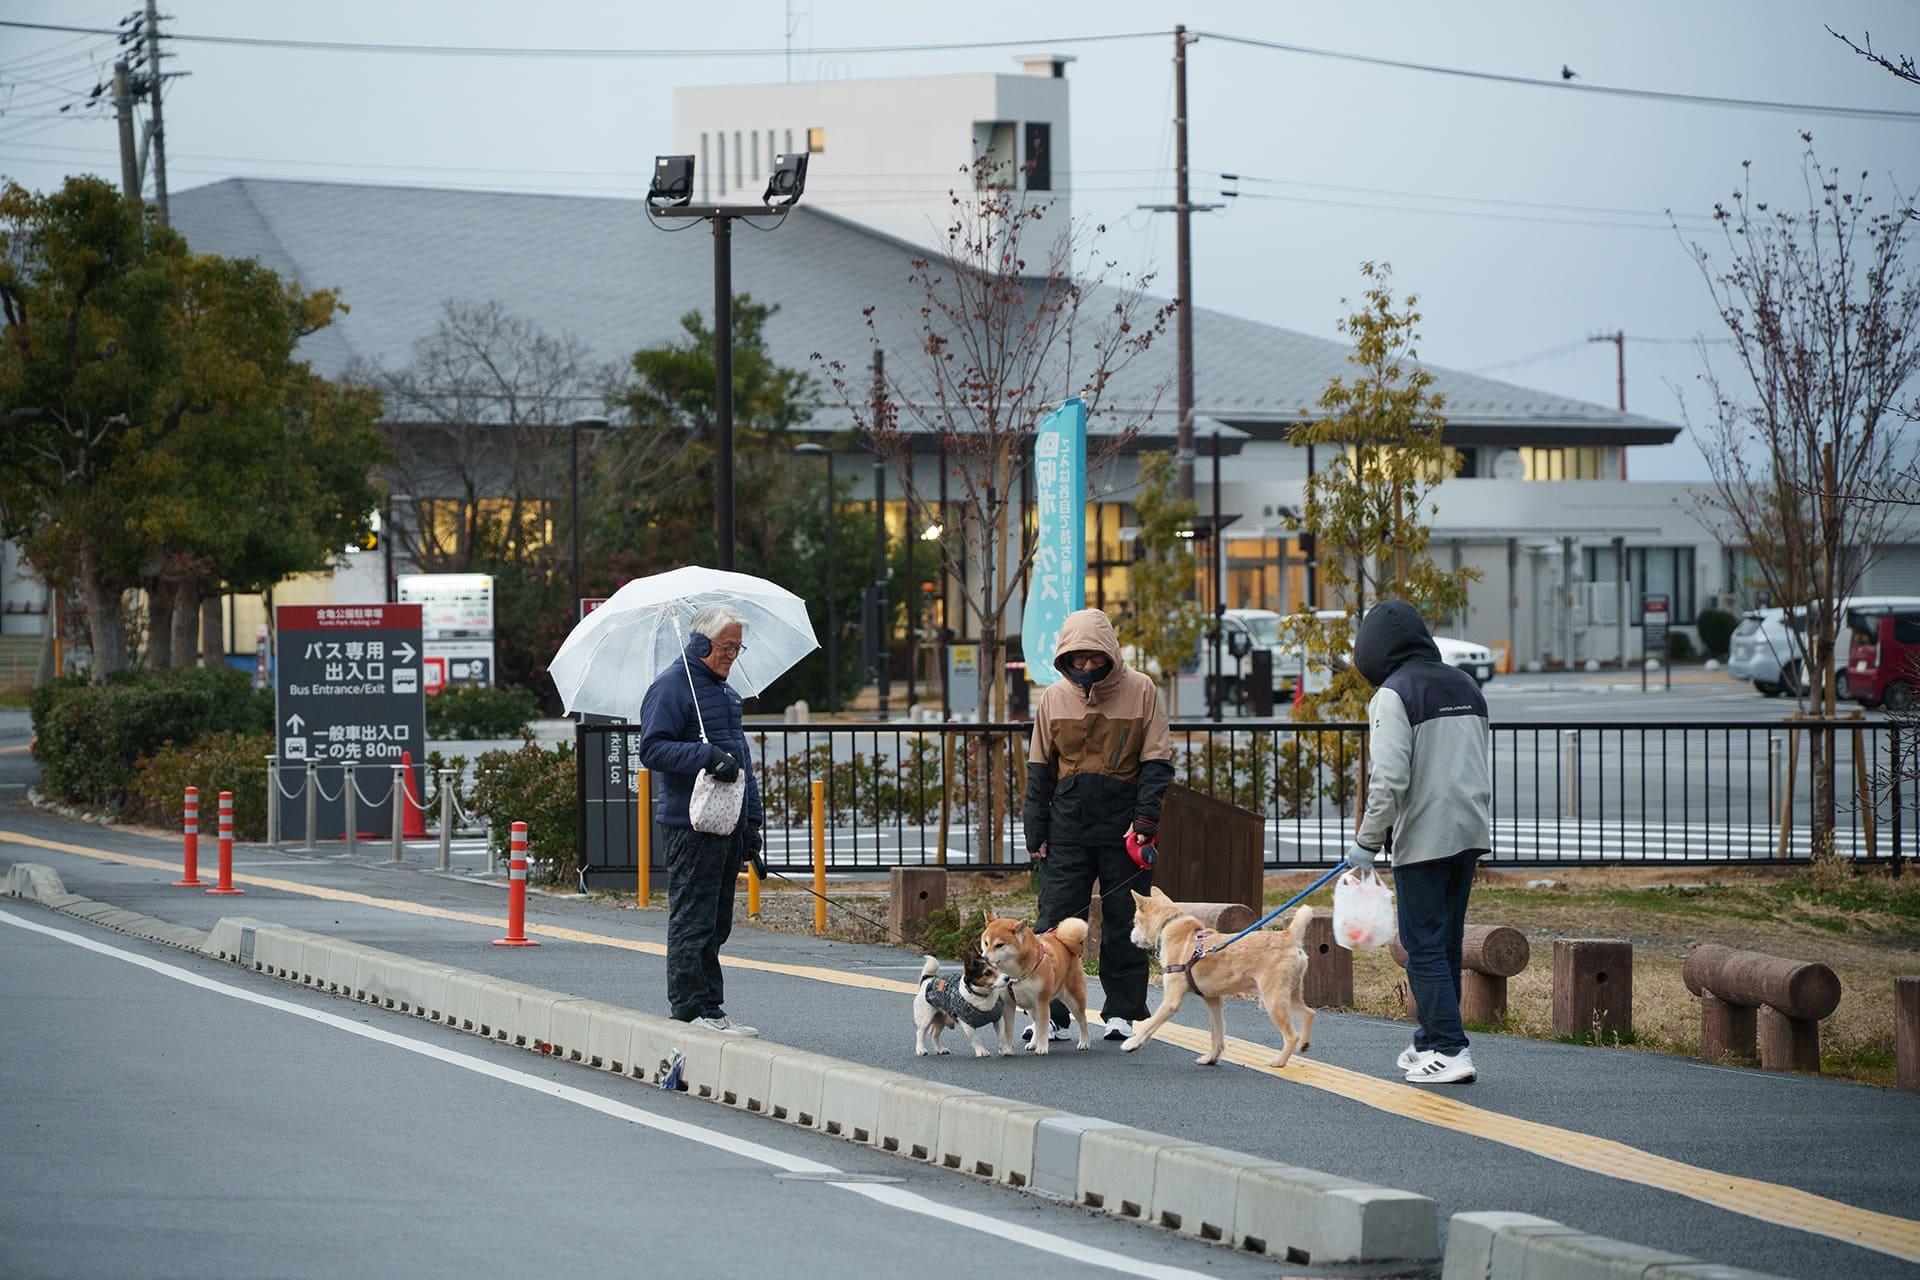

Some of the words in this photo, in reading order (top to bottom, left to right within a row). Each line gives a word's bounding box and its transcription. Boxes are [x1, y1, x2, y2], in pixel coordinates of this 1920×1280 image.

[304, 641, 385, 660] バス専用
[325, 662, 385, 682] 出入口
[290, 683, 310, 696] Bus
[312, 683, 386, 696] Entrance/Exit
[312, 725, 409, 741] 一般車出入口
[608, 720, 622, 763] Prking
[313, 742, 362, 758] この先
[365, 743, 402, 757] 80m
[610, 766, 621, 785] Lot
